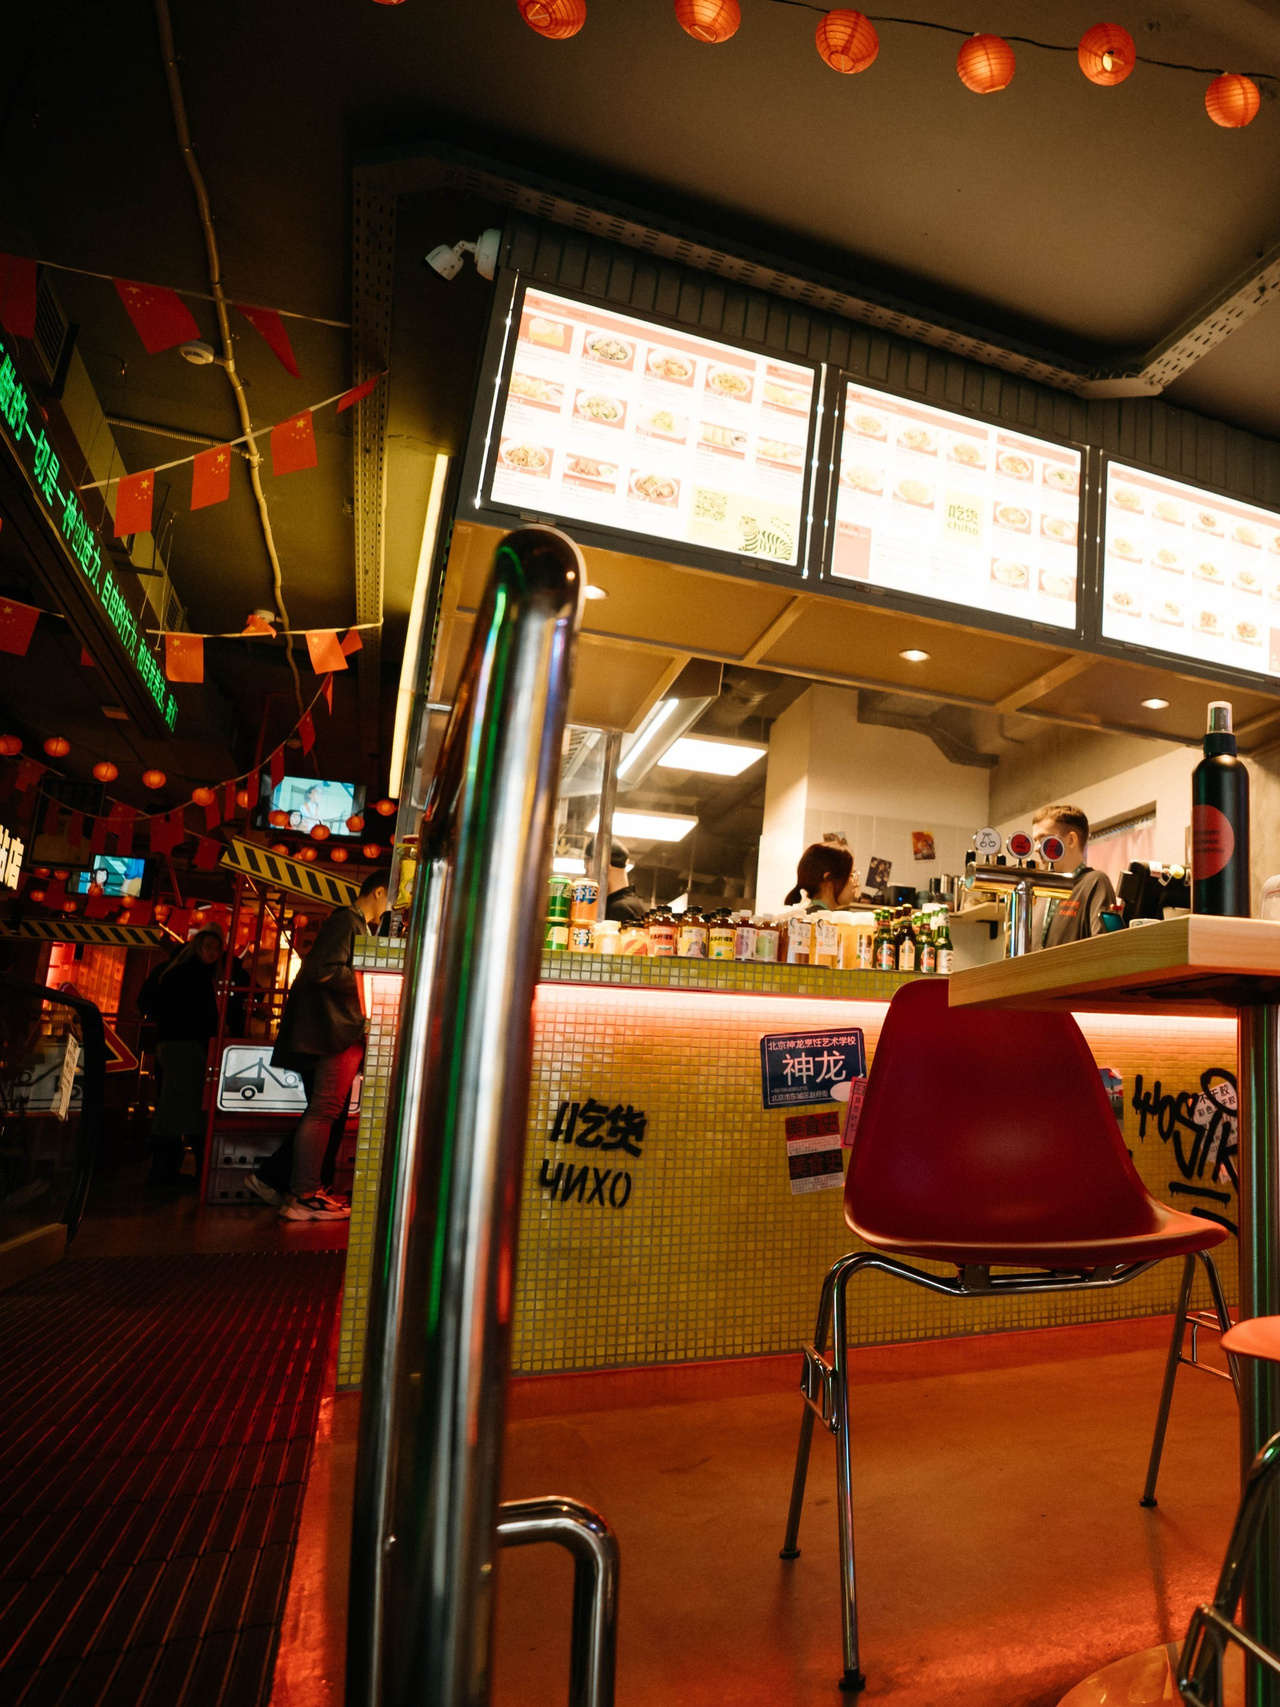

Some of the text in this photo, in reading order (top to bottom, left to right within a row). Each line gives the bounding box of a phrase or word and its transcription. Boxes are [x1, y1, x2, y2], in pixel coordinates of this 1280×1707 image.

[947, 521, 979, 535] chiho
[948, 504, 978, 526] 吃货
[782, 1050, 847, 1086] 神龙
[550, 1098, 648, 1158] 吃货
[540, 1159, 632, 1208] ЧИХО
